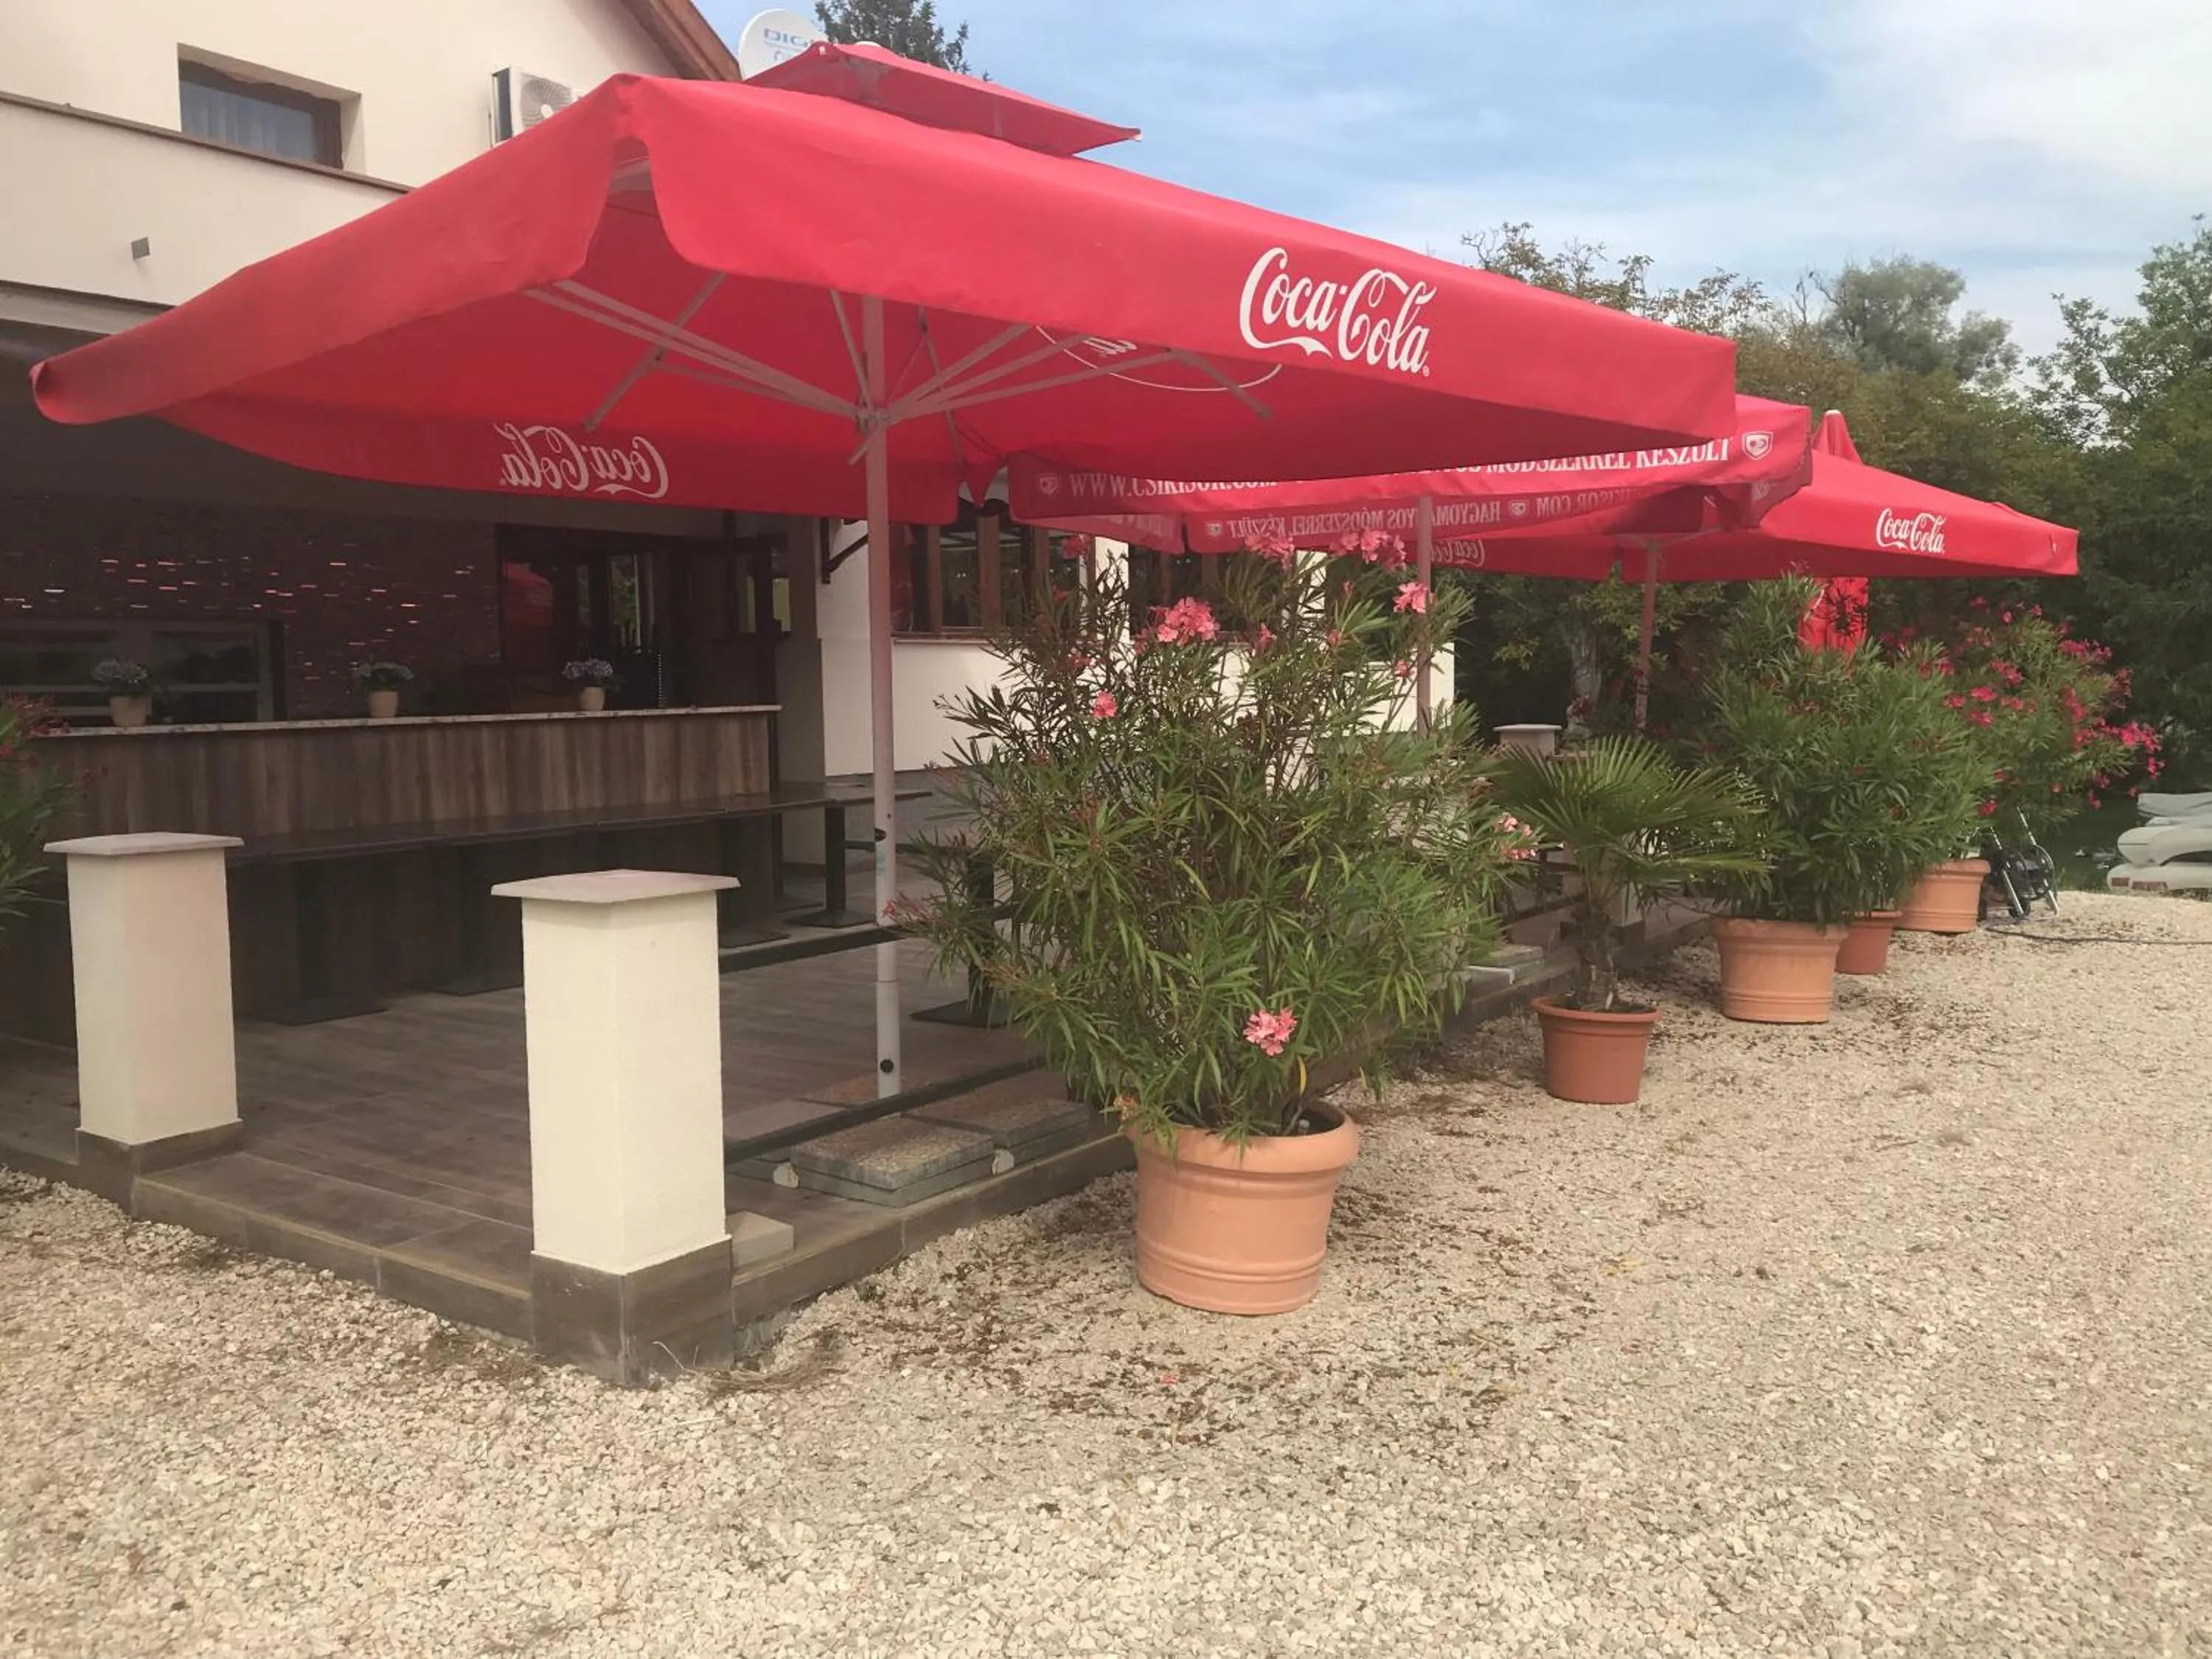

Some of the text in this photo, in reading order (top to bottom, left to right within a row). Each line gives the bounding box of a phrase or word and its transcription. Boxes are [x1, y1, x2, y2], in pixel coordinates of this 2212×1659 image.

[764, 28, 813, 47] DIG
[1240, 247, 1436, 373] Coca-Cola
[1876, 507, 1946, 554] Coca-Cola
